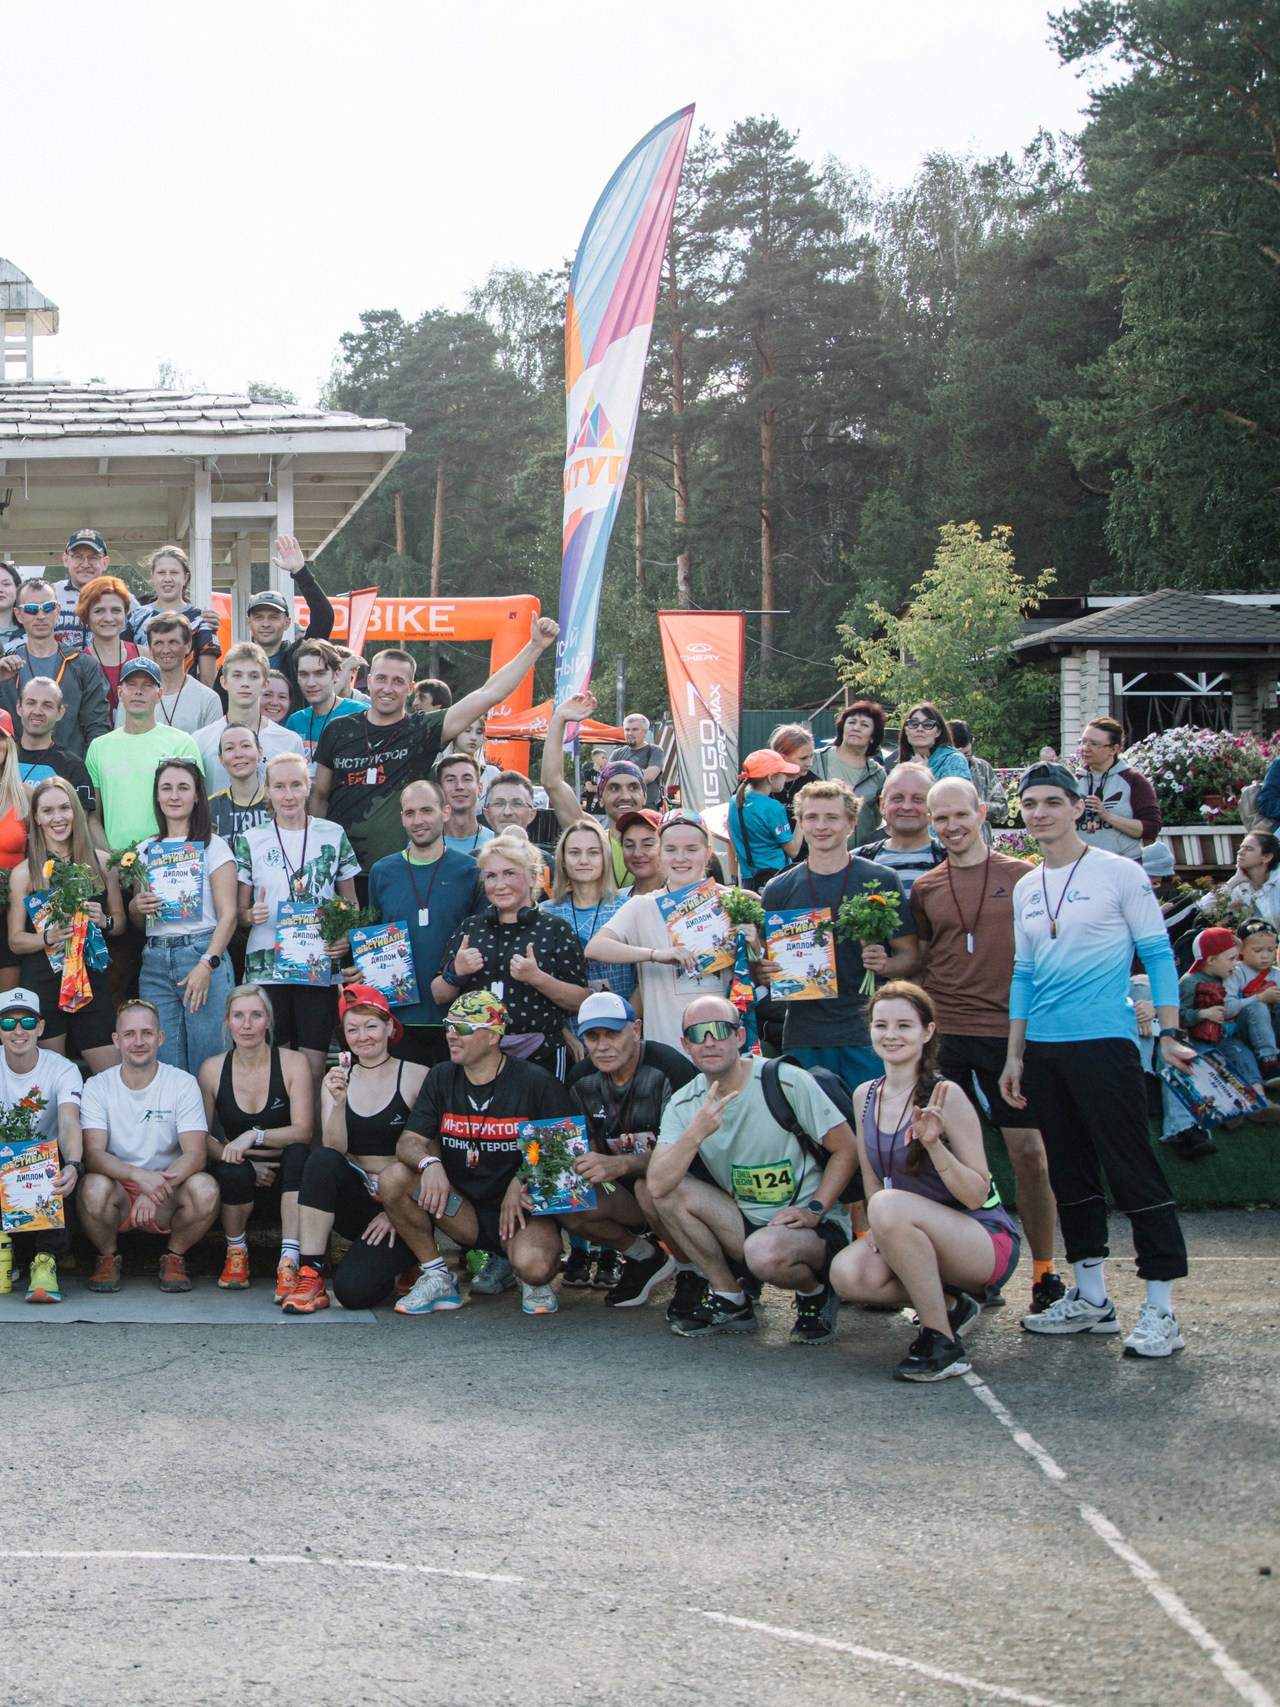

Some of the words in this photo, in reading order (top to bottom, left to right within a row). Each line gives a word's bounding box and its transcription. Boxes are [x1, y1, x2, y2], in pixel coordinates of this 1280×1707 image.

[163, 870, 189, 878] ДИПЛОМ
[281, 917, 320, 925] ФЕСТИВА
[685, 913, 712, 929] ДИПЛОМ
[292, 931, 320, 939] ДИПЛОМ
[786, 942, 816, 951] ДИПЛОМ
[371, 953, 397, 964] ДИПЛОМ
[442, 1136, 476, 1150] ГОНК
[479, 1141, 520, 1152] ГЕРОЕ
[1, 1151, 55, 1171] ФЕСТИВАЛЬ
[16, 1172, 44, 1183] ДИПЛОМ
[752, 1169, 792, 1189] 124
